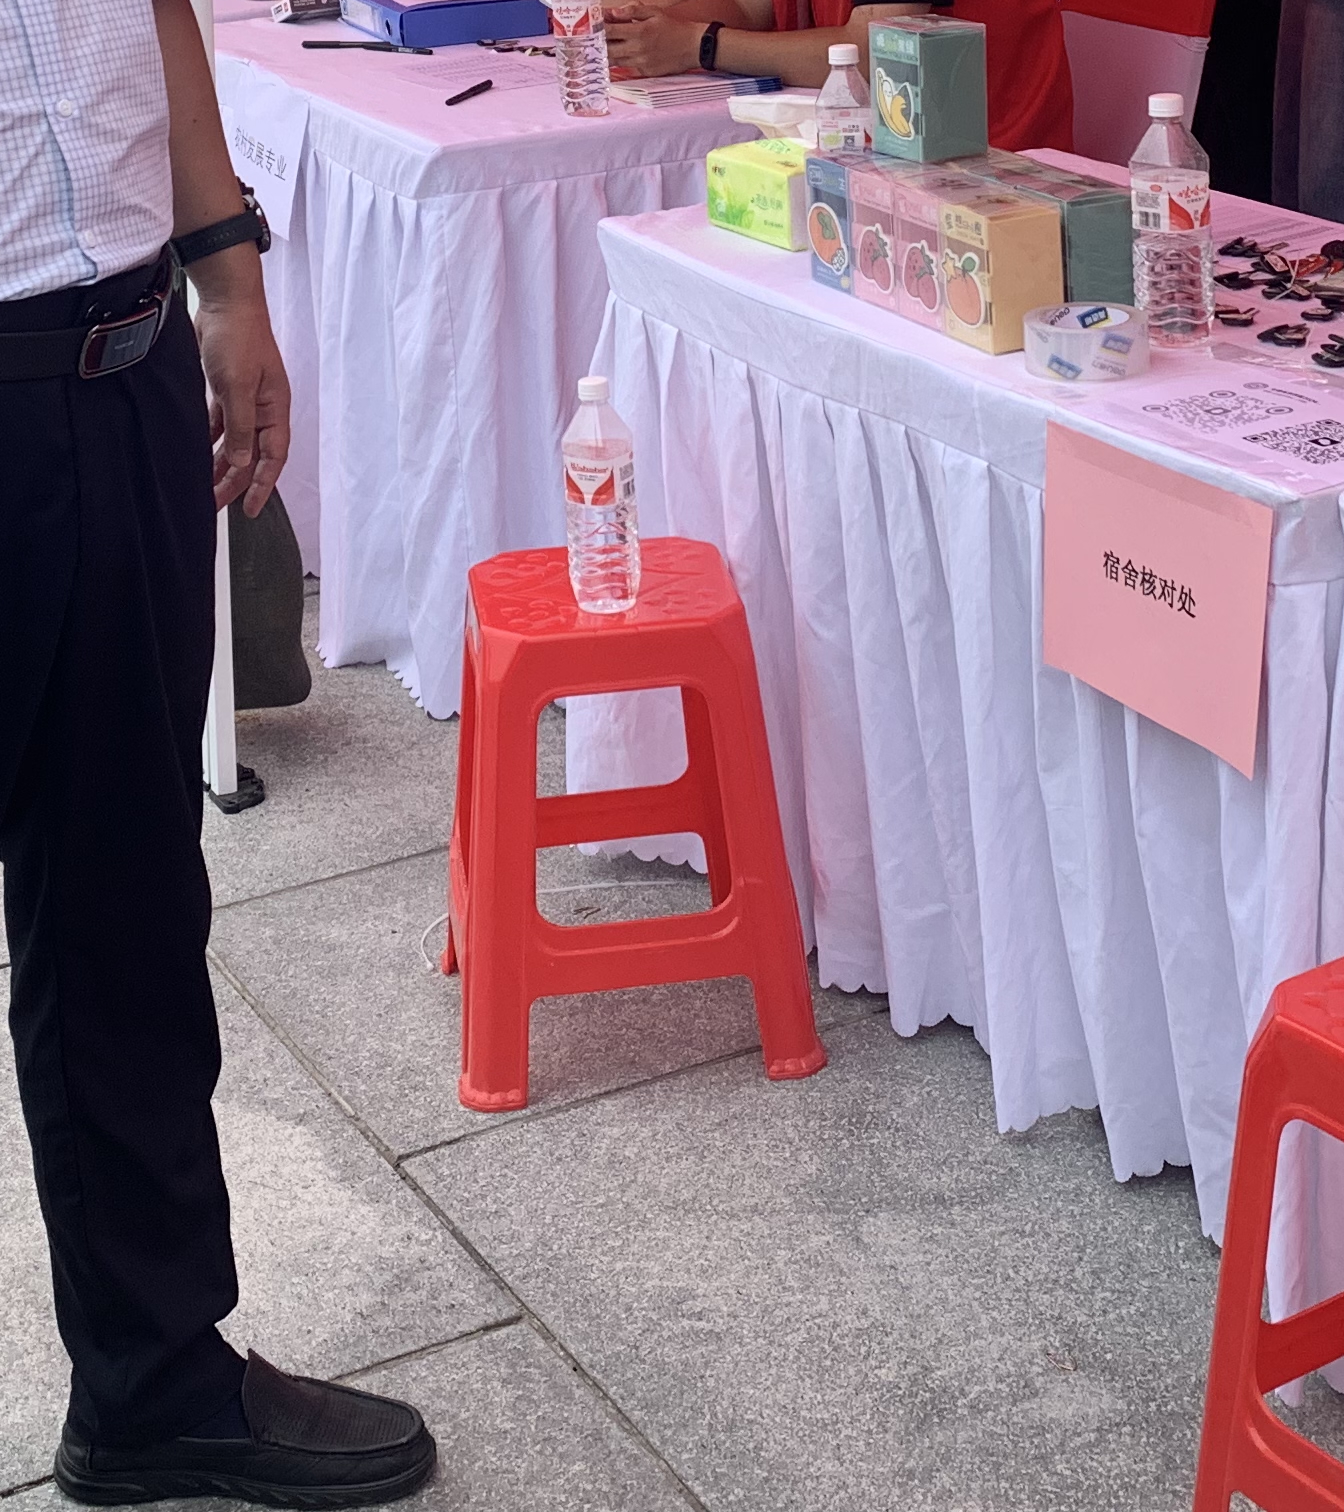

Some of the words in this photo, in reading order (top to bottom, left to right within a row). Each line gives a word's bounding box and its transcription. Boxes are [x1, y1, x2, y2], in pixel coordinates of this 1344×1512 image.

[1102, 550, 1197, 619] 宿舍核对处
